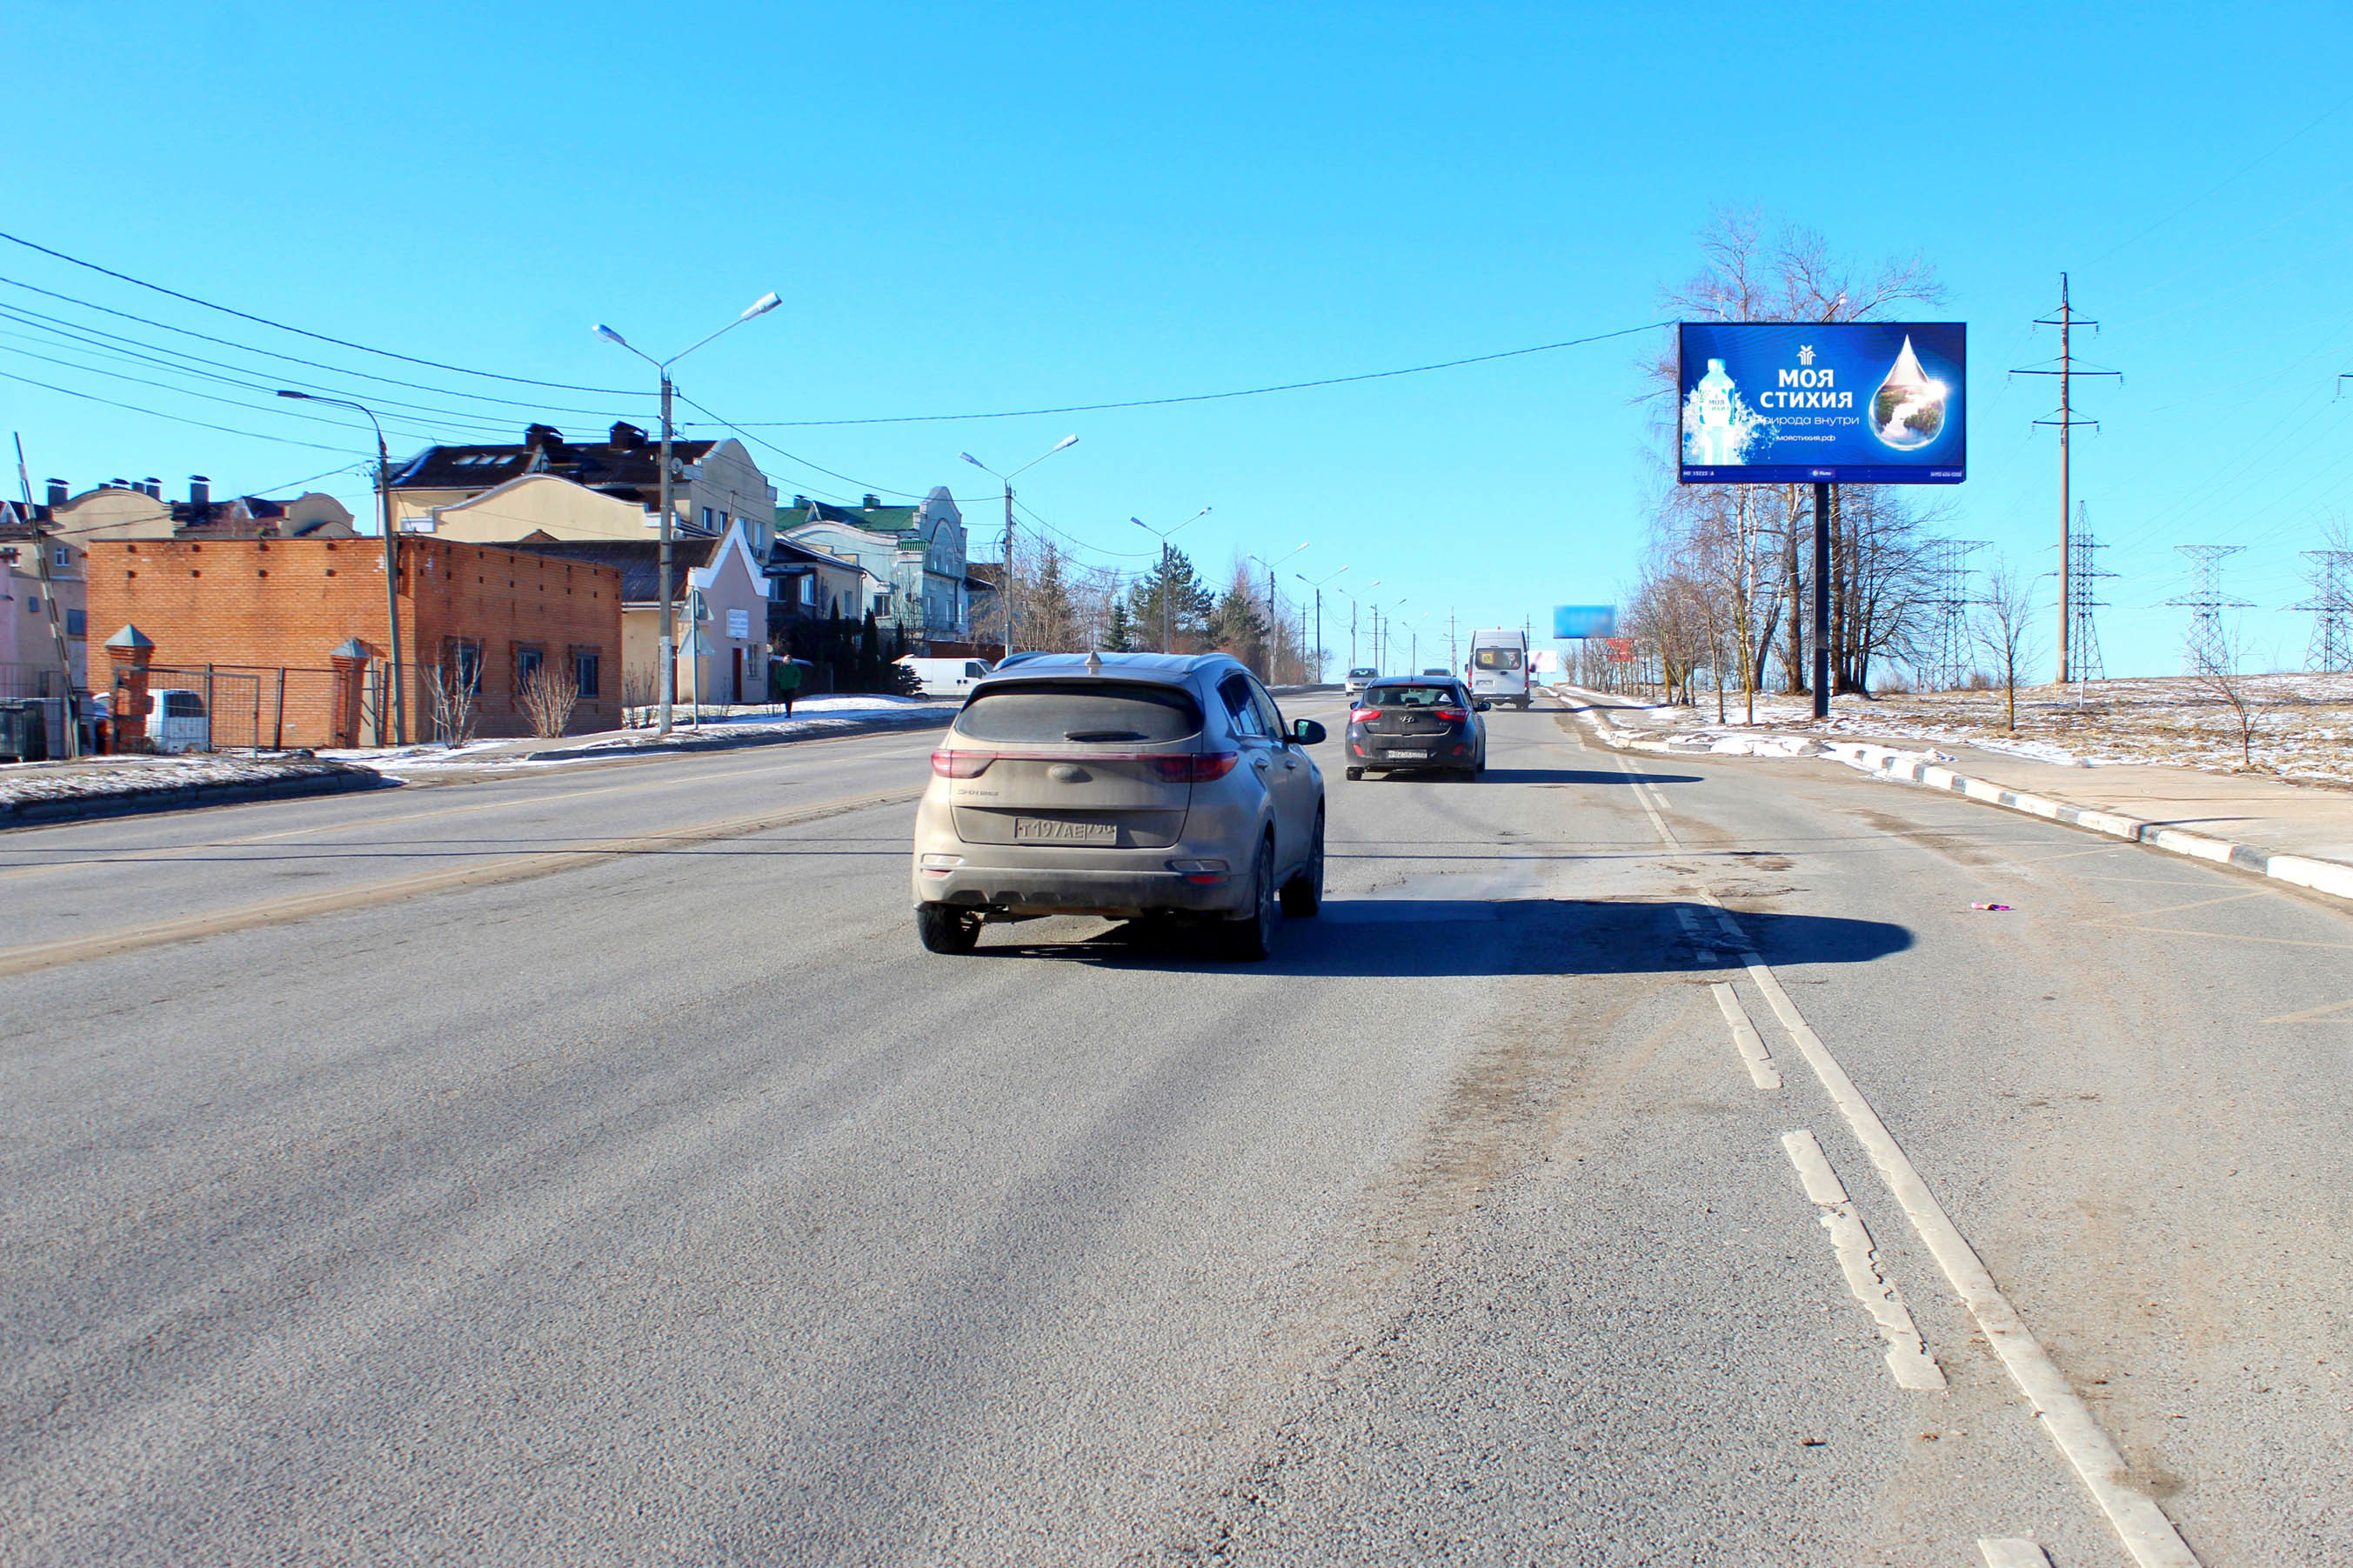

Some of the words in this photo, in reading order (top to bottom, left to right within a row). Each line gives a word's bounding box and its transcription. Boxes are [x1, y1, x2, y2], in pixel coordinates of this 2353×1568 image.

[1779, 369, 1834, 388] МОЯ
[1760, 391, 1853, 409] СТИХИЯ
[1757, 417, 1811, 426] рирода
[1814, 417, 1860, 426] внутри
